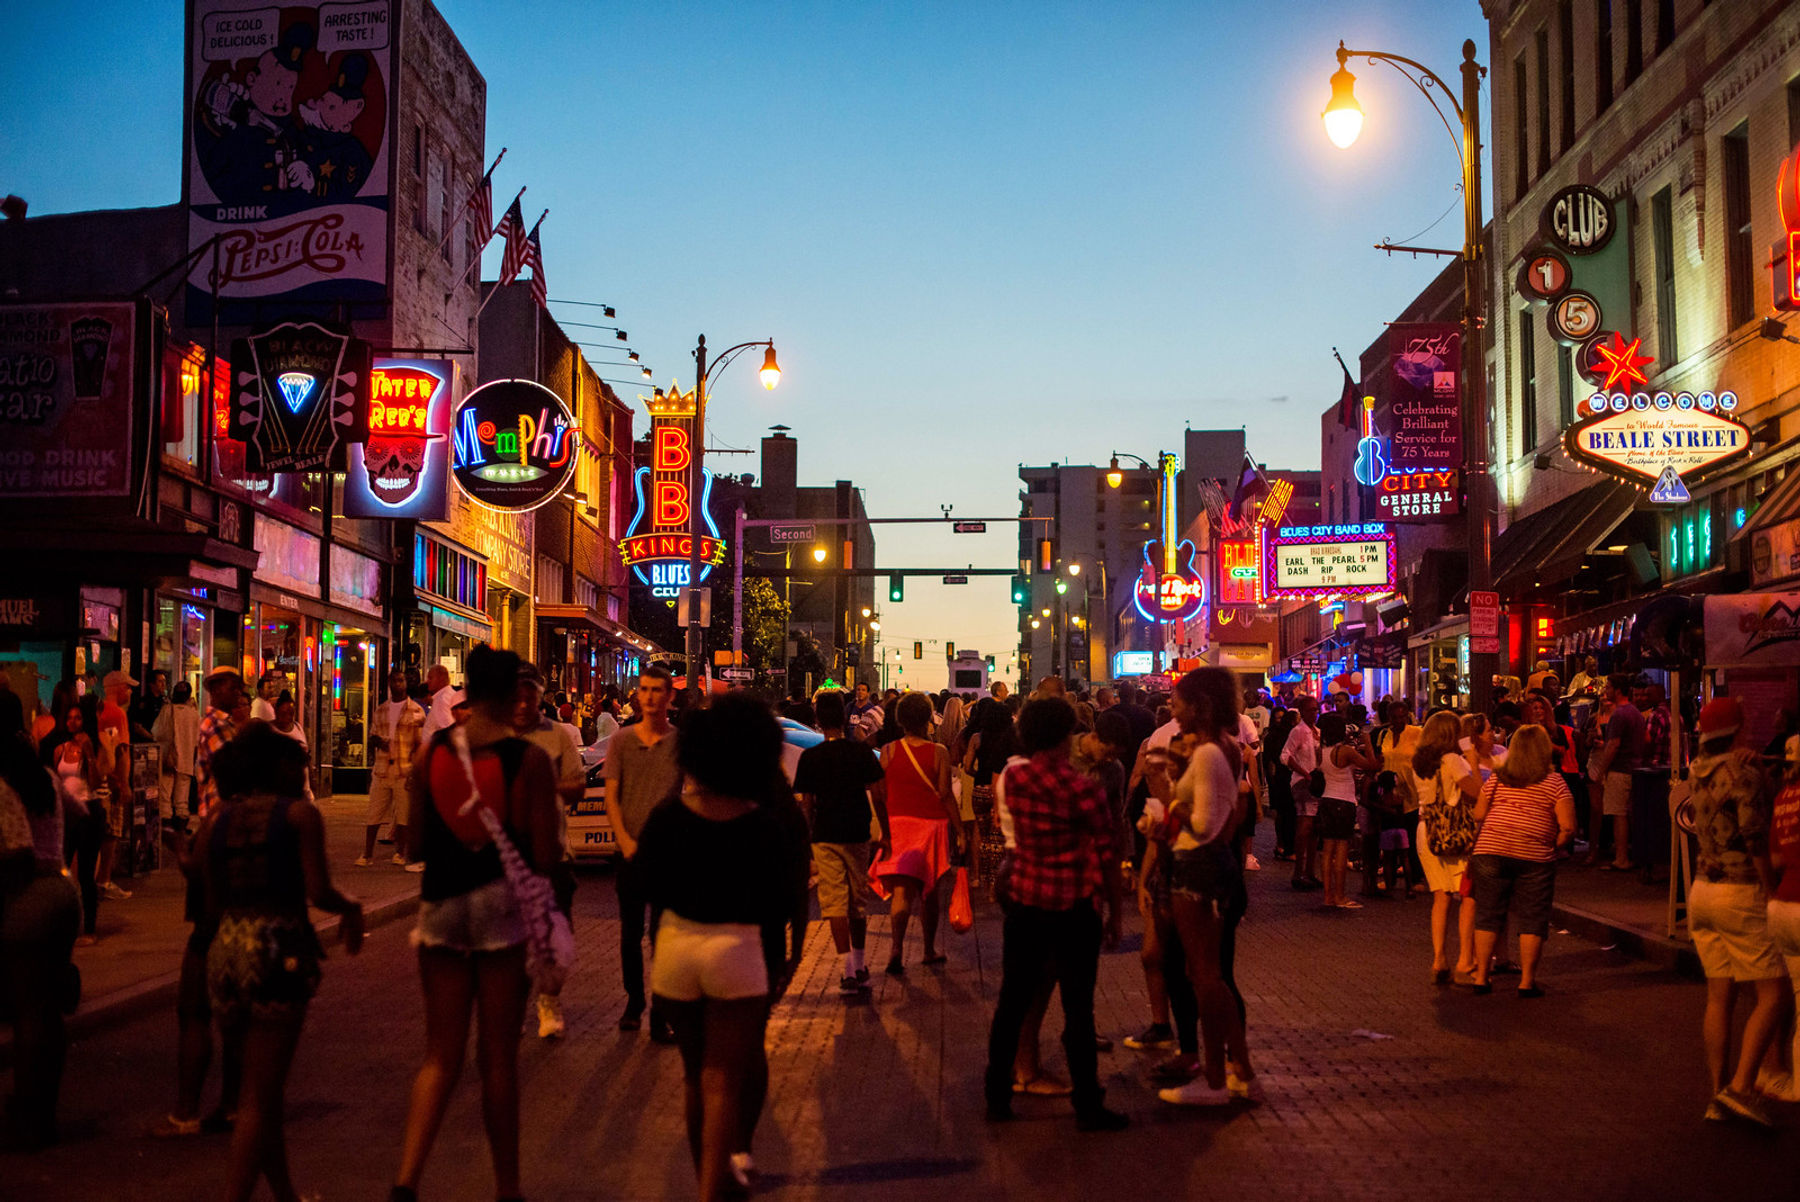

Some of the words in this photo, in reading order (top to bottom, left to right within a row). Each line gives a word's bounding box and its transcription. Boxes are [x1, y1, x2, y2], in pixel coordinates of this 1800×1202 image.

[215, 20, 232, 33] ICE
[235, 19, 263, 32] COLD
[324, 10, 387, 27] ARRESTING
[216, 205, 268, 221] DRINK
[1553, 192, 1609, 247] CLUB
[1536, 260, 1555, 290] 1
[1565, 301, 1590, 332] 5
[1408, 332, 1460, 364] 75th
[1392, 400, 1459, 418] Celebrating
[1591, 393, 1734, 411] WELCOME
[1402, 417, 1449, 430] Brilliant
[1636, 420, 1664, 430] World
[1668, 420, 1699, 430] Famous
[1394, 431, 1434, 444] Service
[1440, 430, 1457, 444] for
[1589, 431, 1655, 449] BEALE
[1662, 429, 1740, 448] STREET
[45, 450, 117, 466] DRINK
[1401, 446, 1418, 458] 75
[1421, 446, 1451, 458] Years
[40, 469, 109, 488] MUSIC
[1382, 471, 1453, 492] CITY
[1380, 491, 1453, 507] GENERAL
[1392, 503, 1442, 517] STORE
[773, 527, 812, 541] Second
[1280, 526, 1310, 538] BLUES
[1311, 525, 1334, 536] CITY
[1334, 524, 1361, 535] BAND
[1363, 522, 1385, 534] BOX
[1364, 545, 1377, 553] PM
[508, 544, 531, 581] STORE
[1285, 557, 1305, 566] EARL
[1312, 556, 1325, 565] THE
[1332, 555, 1357, 564] PEARL
[1360, 555, 1365, 563] 5
[1366, 555, 1379, 563] PM
[652, 564, 691, 585] BLUES
[1287, 567, 1309, 576] DASH
[1321, 566, 1334, 574] RIP
[1346, 564, 1367, 573] ROCK
[652, 587, 681, 597] CLU
[1172, 579, 1202, 598] Rock
[280, 594, 299, 609] ENTER
[1476, 594, 1493, 606] NO
[584, 831, 616, 844] POLI
